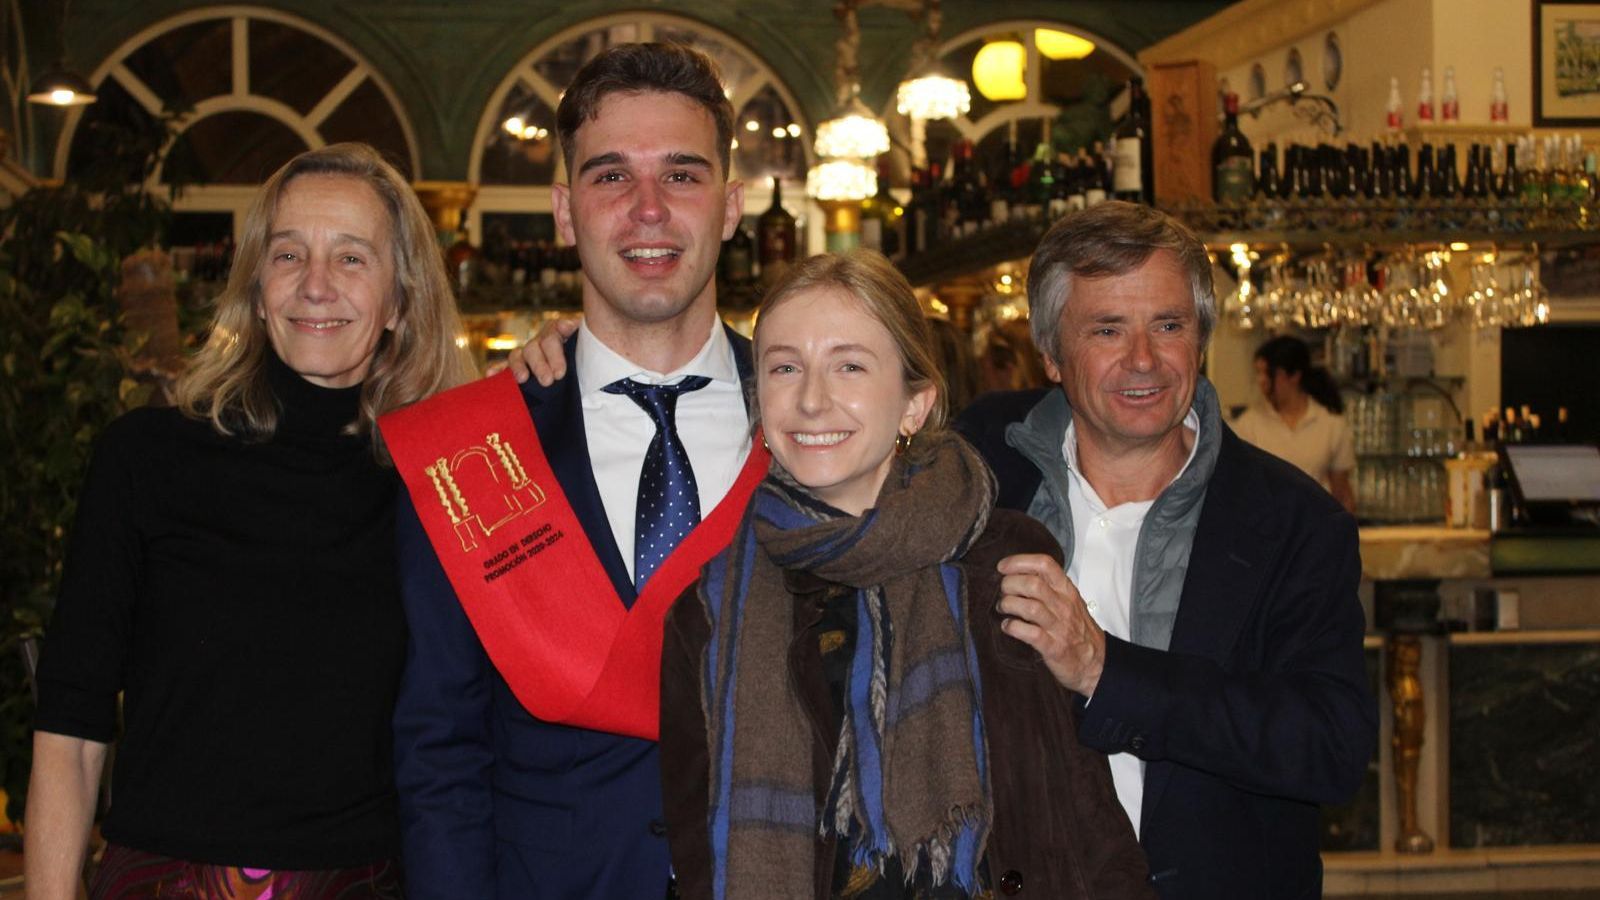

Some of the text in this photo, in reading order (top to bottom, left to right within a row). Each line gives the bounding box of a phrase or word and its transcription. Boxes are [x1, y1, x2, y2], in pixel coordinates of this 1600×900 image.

[484, 523, 551, 569] GRADO EN DERECHO
[527, 530, 564, 557] 2020-2024
